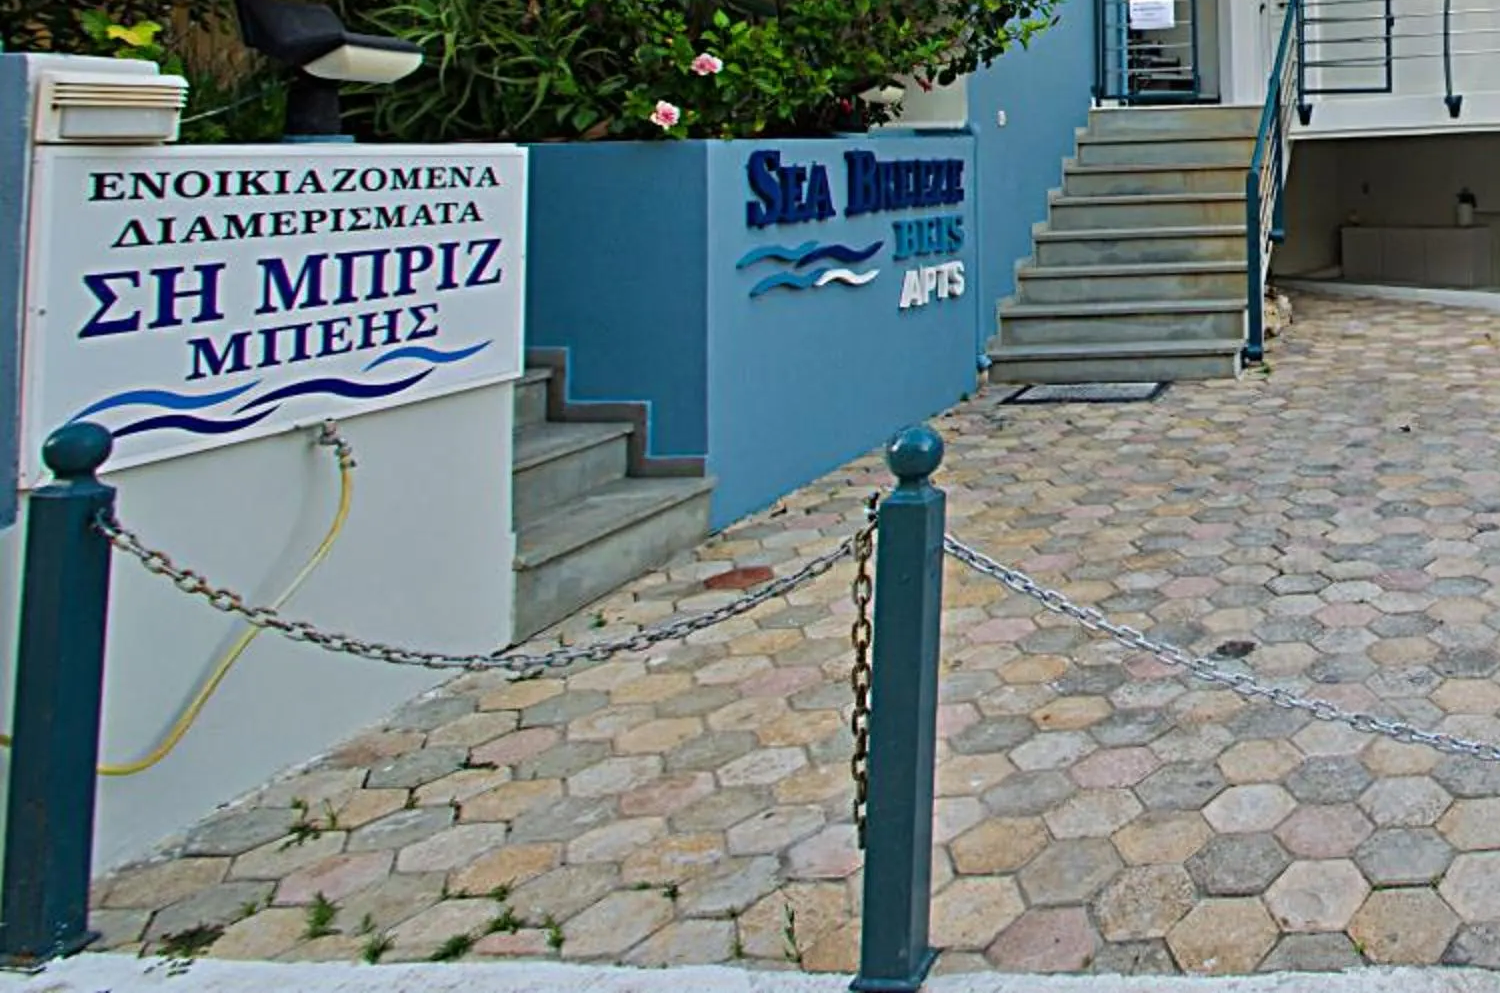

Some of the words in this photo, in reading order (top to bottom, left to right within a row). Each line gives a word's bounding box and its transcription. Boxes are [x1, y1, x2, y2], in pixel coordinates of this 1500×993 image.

[87, 166, 501, 202] ΕΝΟΙΚΙΑΖΟΜΕΝΑ
[746, 149, 837, 229] SEA
[844, 149, 965, 217] BREEZE
[110, 201, 484, 248] ΔΙΑΜΕΡΙΣΜΑΤΑ
[893, 215, 965, 262] BEIS
[77, 262, 227, 339] ΣΗ
[255, 238, 503, 316] ΜΠΡΙΖ
[899, 260, 965, 309] APTS
[185, 303, 440, 381] ΜΠΕΗΣ
